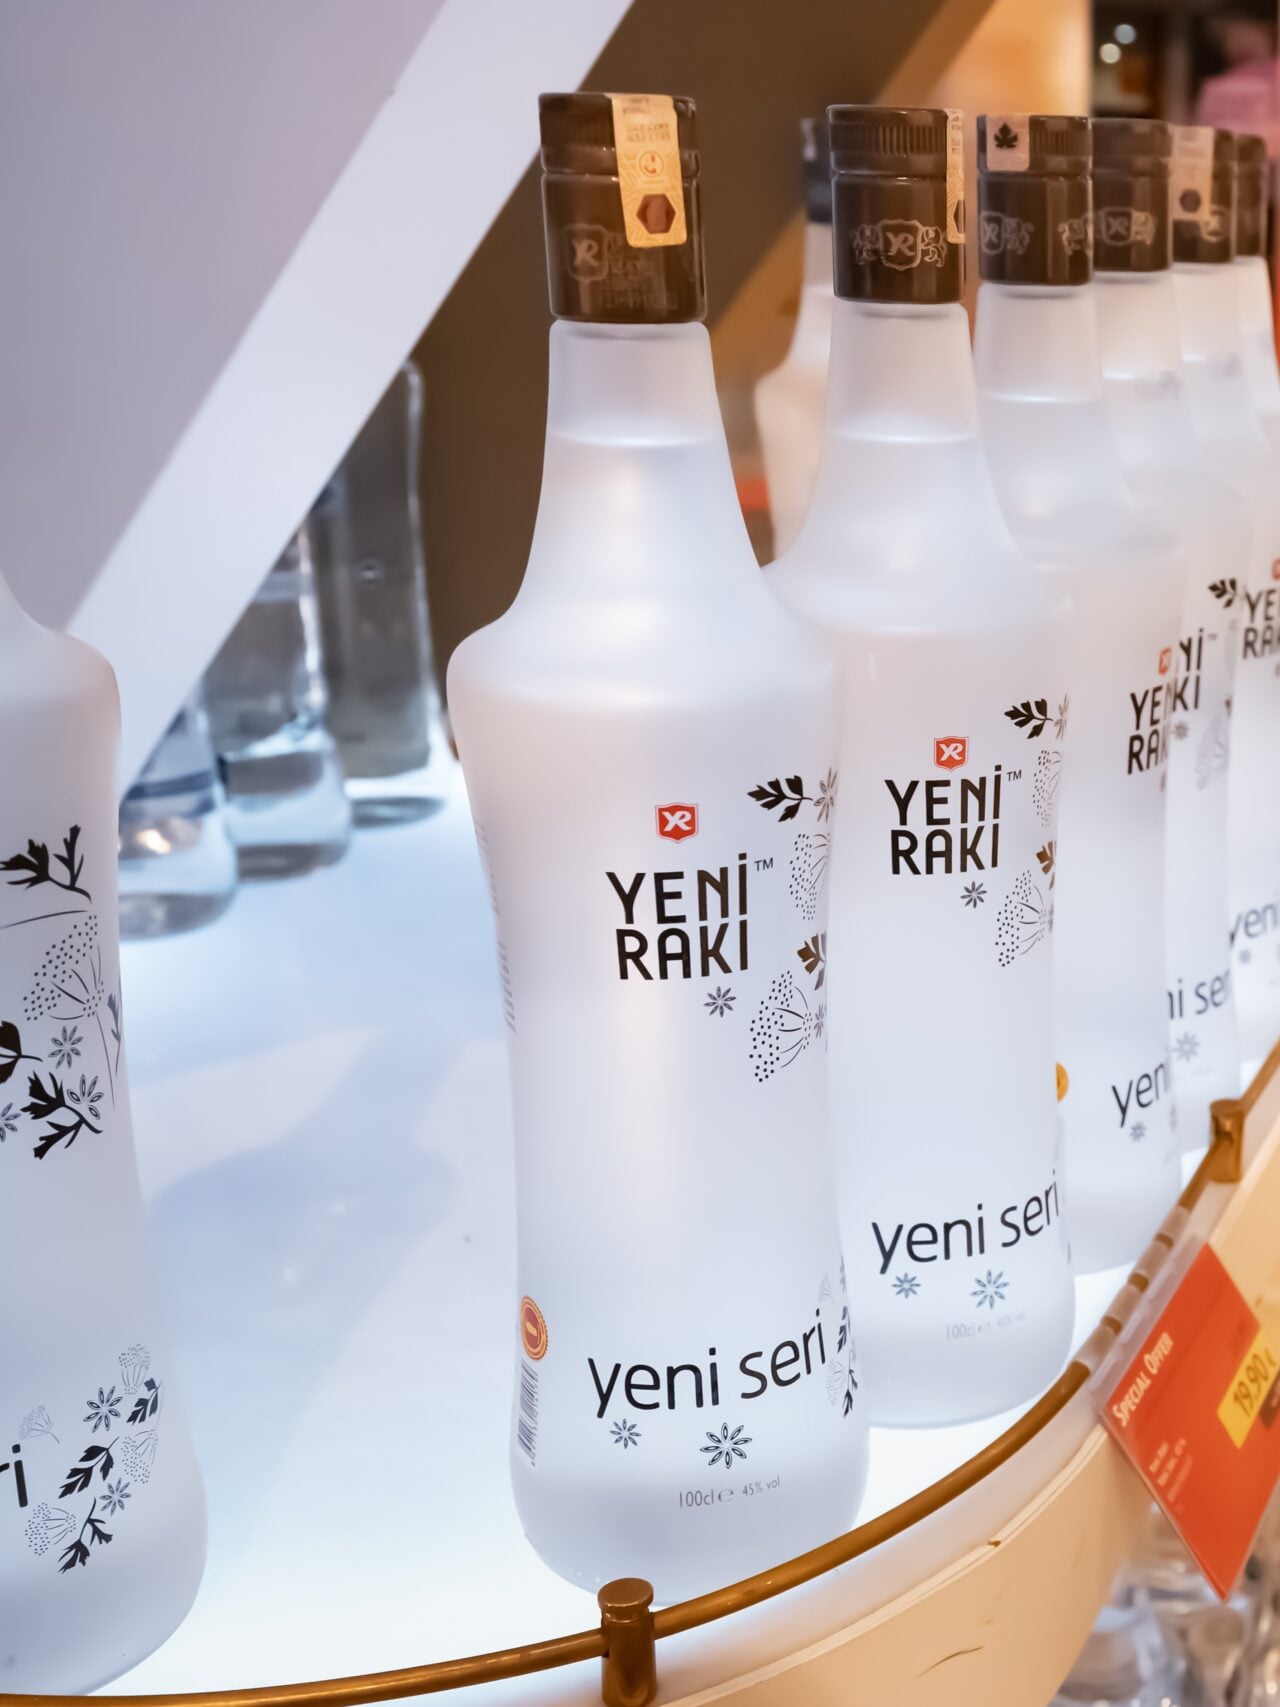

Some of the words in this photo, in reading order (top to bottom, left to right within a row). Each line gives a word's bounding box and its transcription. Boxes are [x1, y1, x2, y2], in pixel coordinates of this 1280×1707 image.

[890, 822, 1000, 875] RAKI
[615, 919, 749, 981] RAKI
[871, 1203, 986, 1275] yeni
[1000, 1168, 1059, 1248] seri
[587, 1347, 720, 1419] yeni
[738, 1308, 827, 1399] seri
[679, 1488, 715, 1508] 100cl
[766, 1474, 781, 1490] vol
